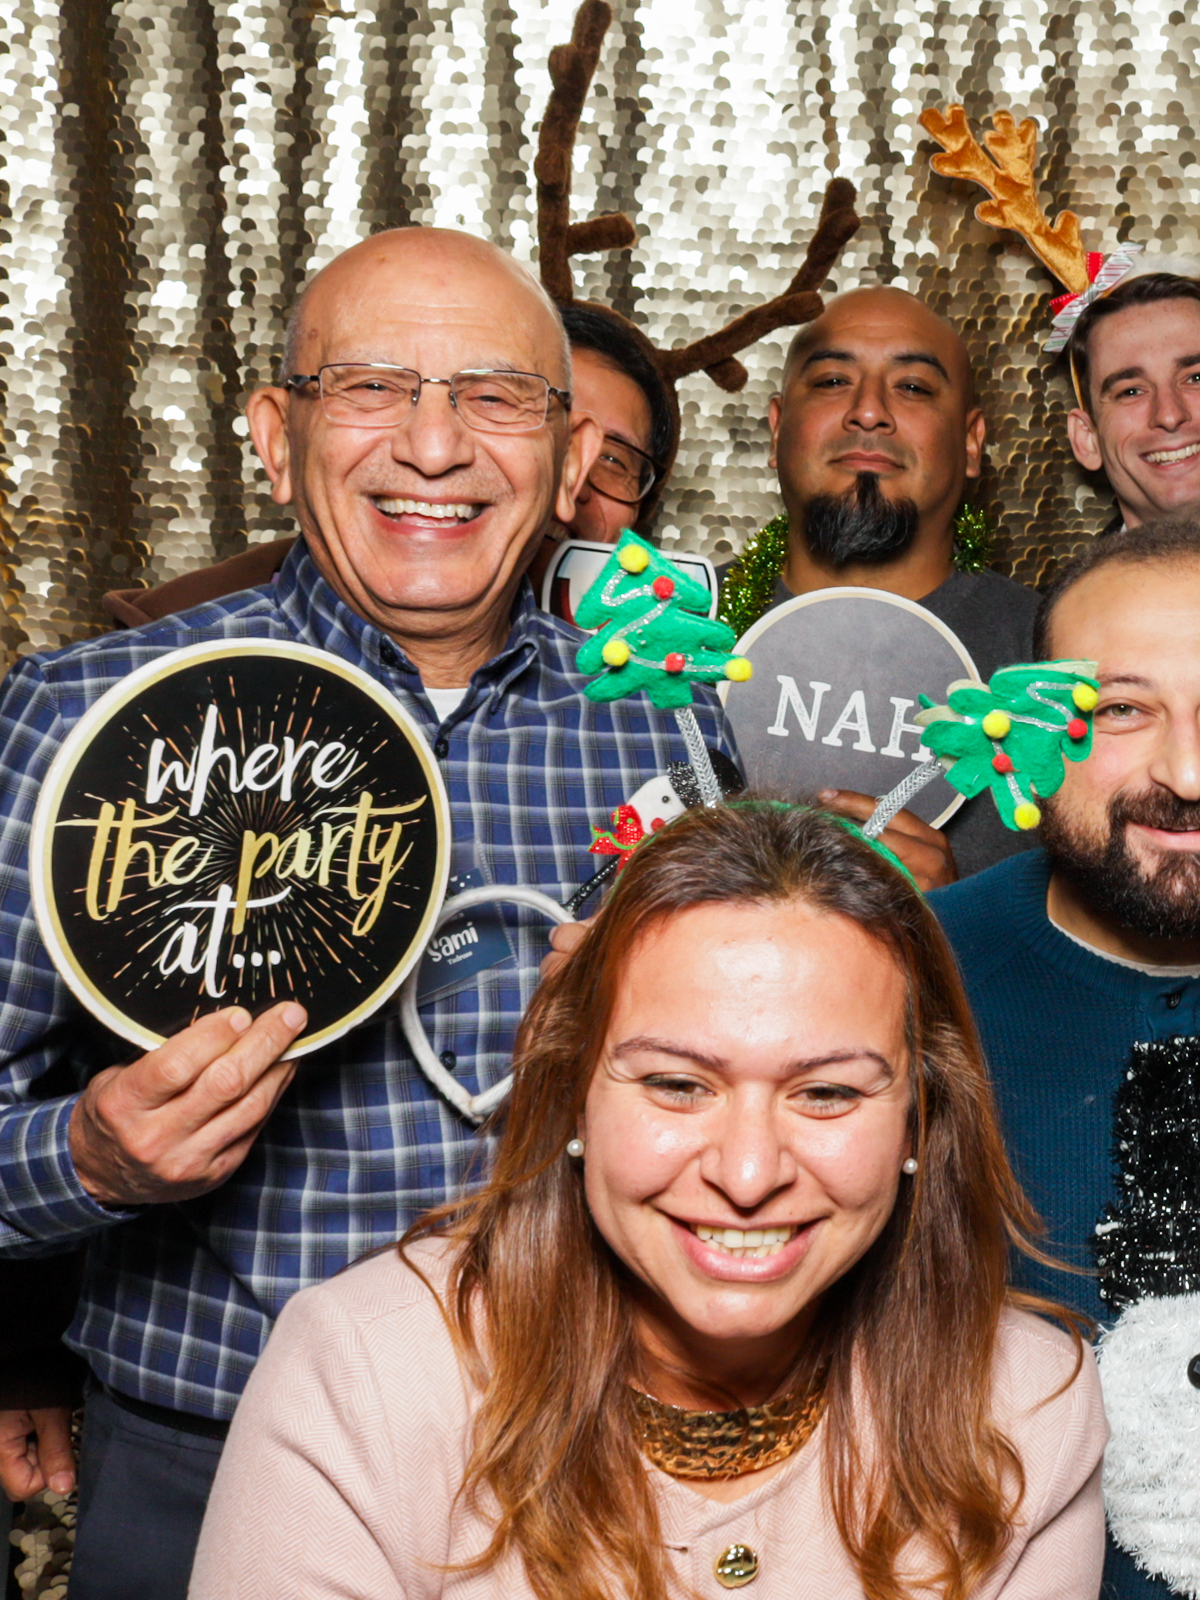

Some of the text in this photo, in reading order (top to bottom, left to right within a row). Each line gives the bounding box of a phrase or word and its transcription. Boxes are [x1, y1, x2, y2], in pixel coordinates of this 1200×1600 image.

[146, 704, 359, 817] where
[767, 674, 935, 763] NAH
[55, 791, 428, 937] the party
[426, 920, 480, 963] Sami
